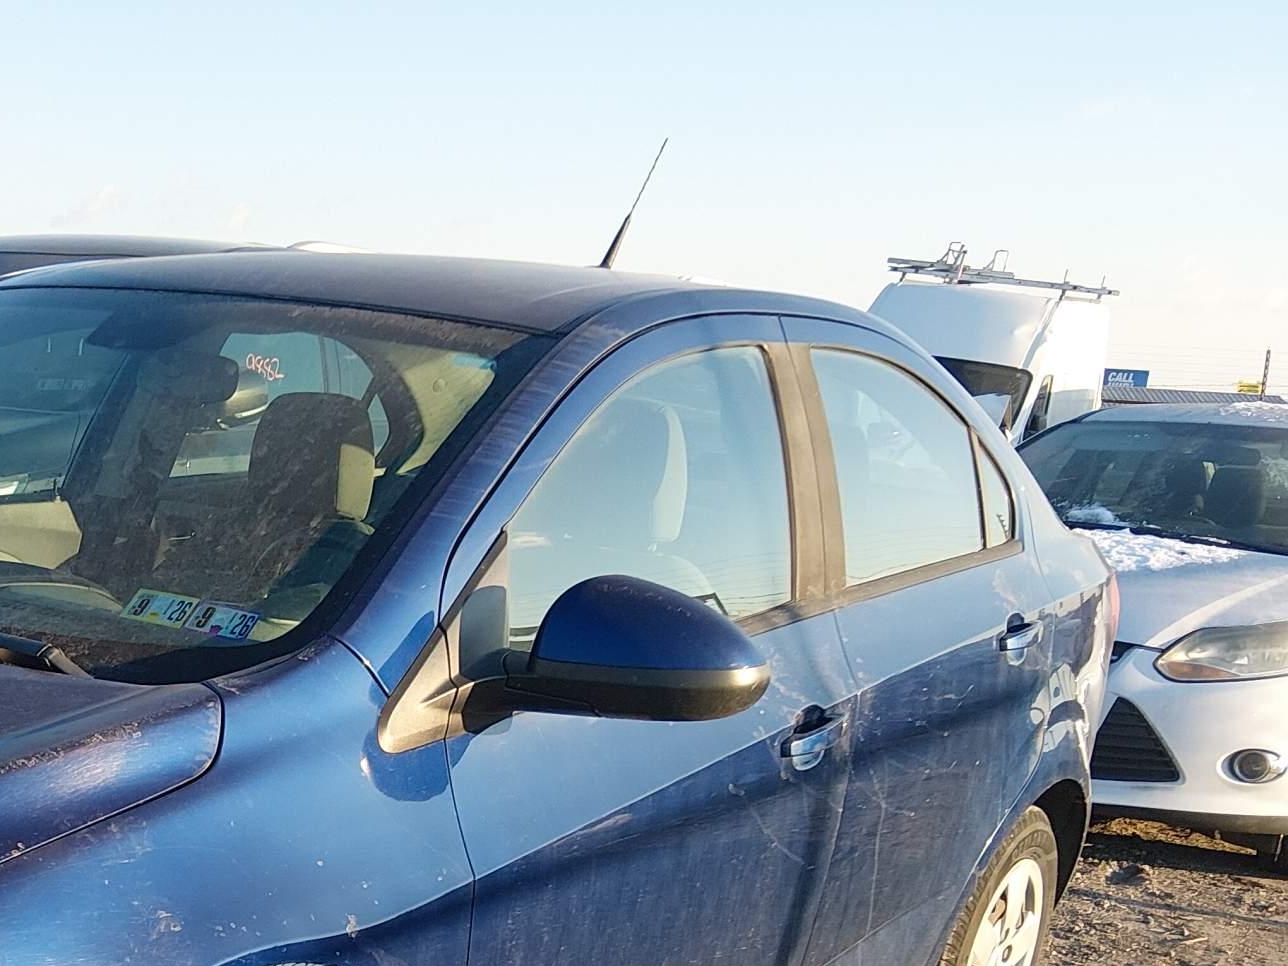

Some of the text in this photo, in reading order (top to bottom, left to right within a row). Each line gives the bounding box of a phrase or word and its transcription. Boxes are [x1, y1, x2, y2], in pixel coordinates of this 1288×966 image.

[1108, 371, 1134, 382] CALL
[134, 598, 193, 622] 9 26
[196, 606, 256, 636] 9 26
